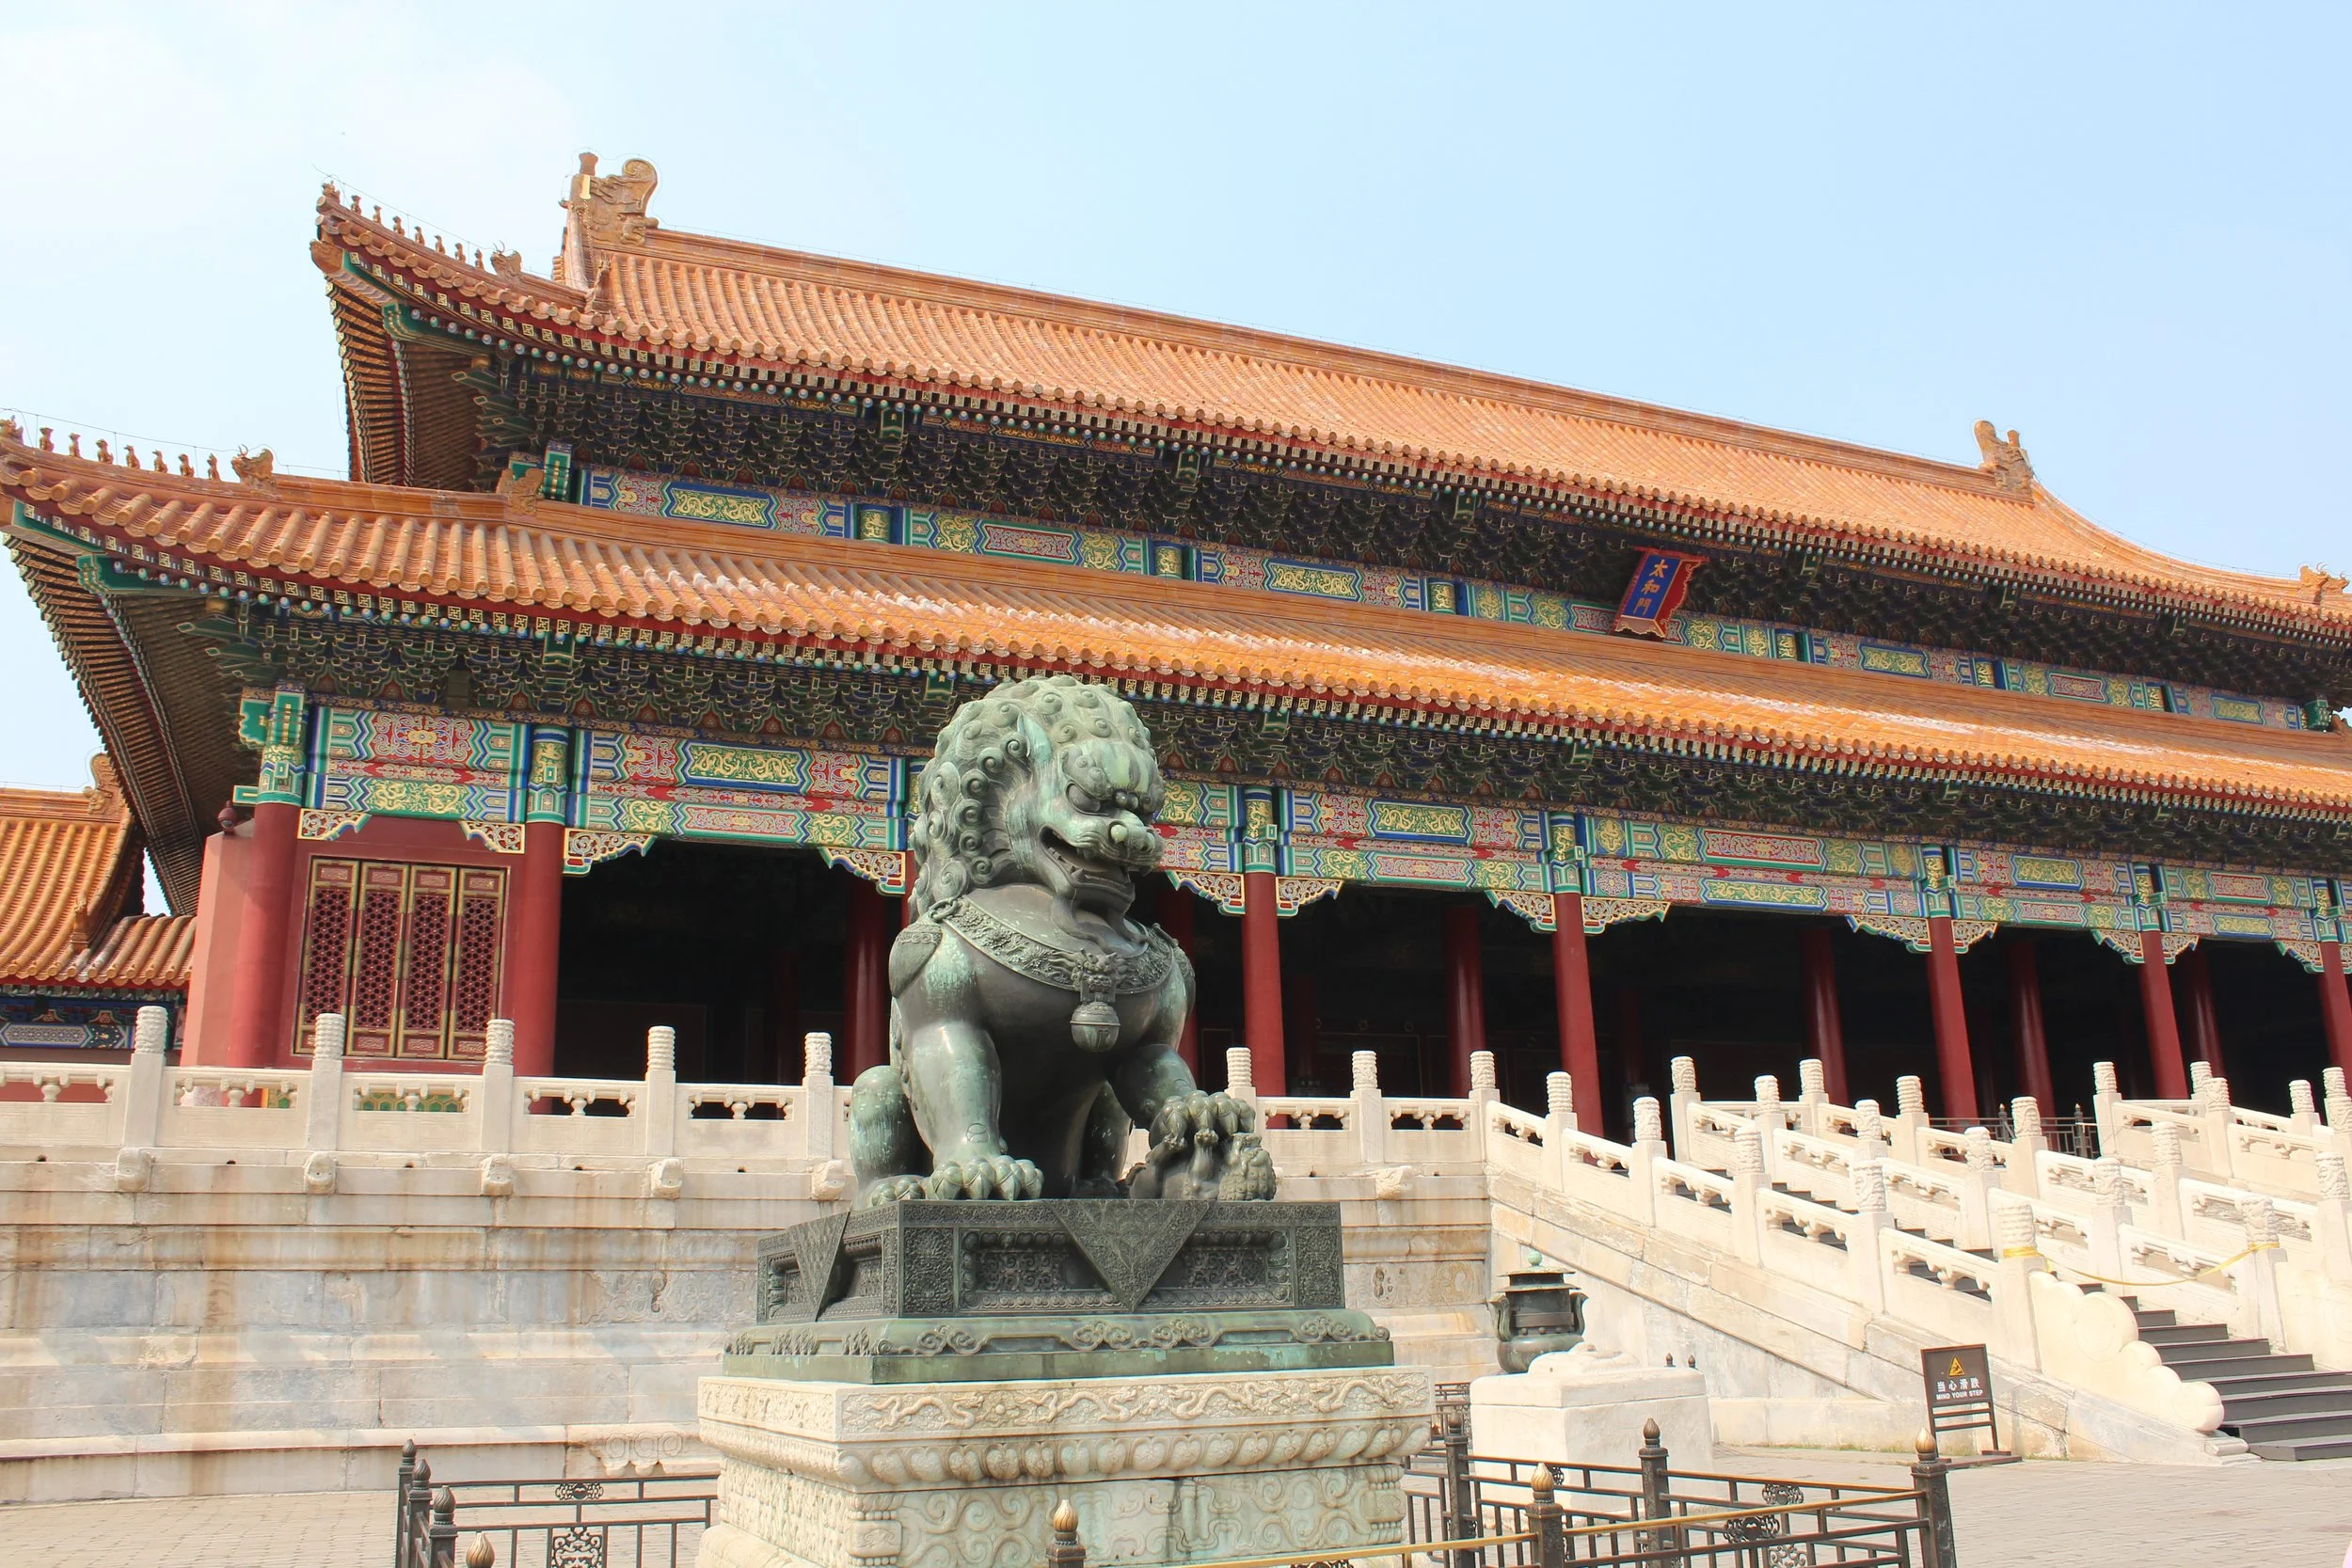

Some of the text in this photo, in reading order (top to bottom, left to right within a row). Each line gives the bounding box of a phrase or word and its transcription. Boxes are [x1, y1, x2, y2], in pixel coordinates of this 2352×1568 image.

[1632, 558, 1669, 616] 太和門
[1937, 1377, 1980, 1392] 当心滑跌
